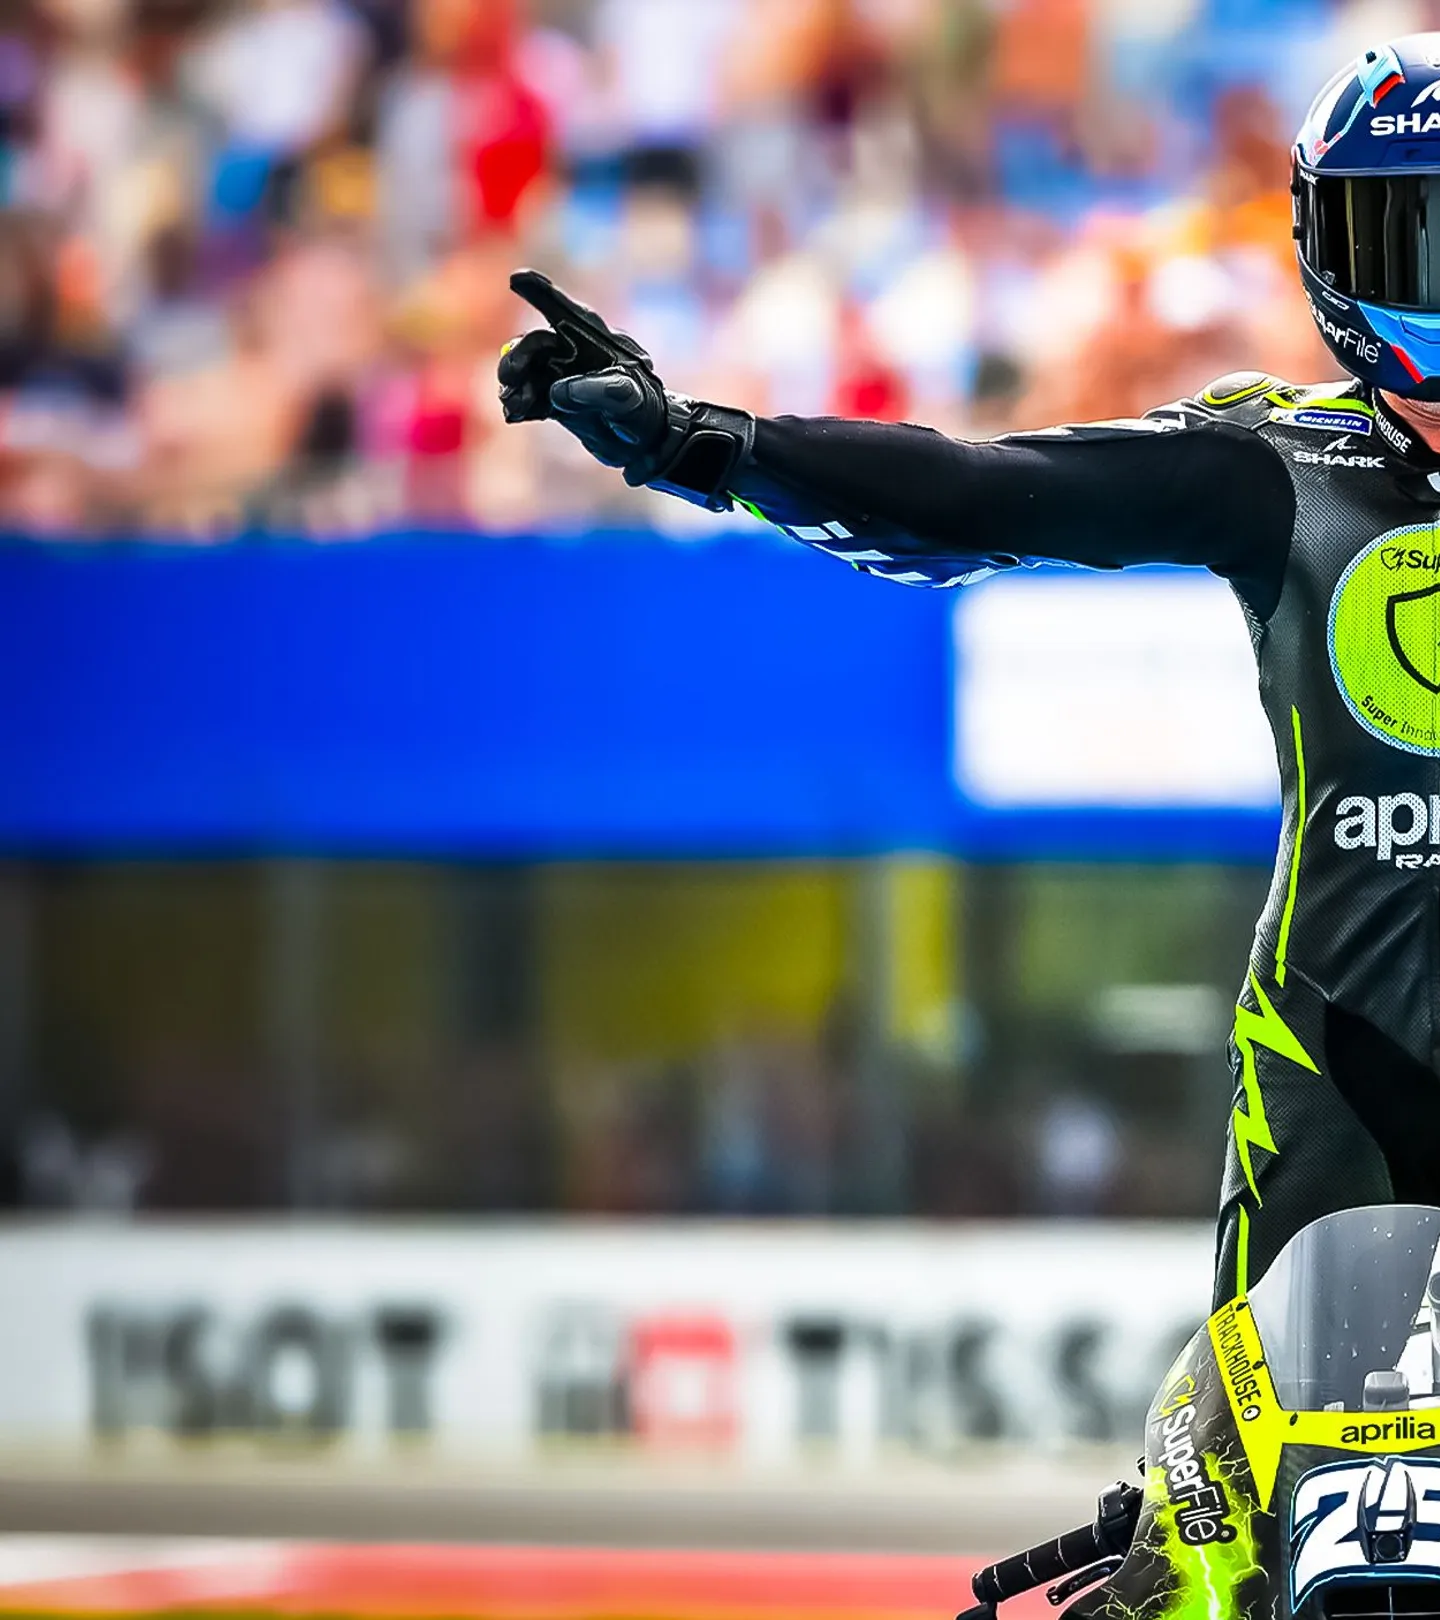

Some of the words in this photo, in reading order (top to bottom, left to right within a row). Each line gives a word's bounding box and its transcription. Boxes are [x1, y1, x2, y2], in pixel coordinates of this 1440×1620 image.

[1299, 414, 1362, 427] MICHELIN
[1293, 451, 1385, 468] SHARK
[1361, 695, 1398, 728] Super
[1215, 1304, 1262, 1406] TRACKHOUSE
[1341, 1417, 1436, 1444] aprilia
[1158, 1404, 1223, 1541] SuperFile
